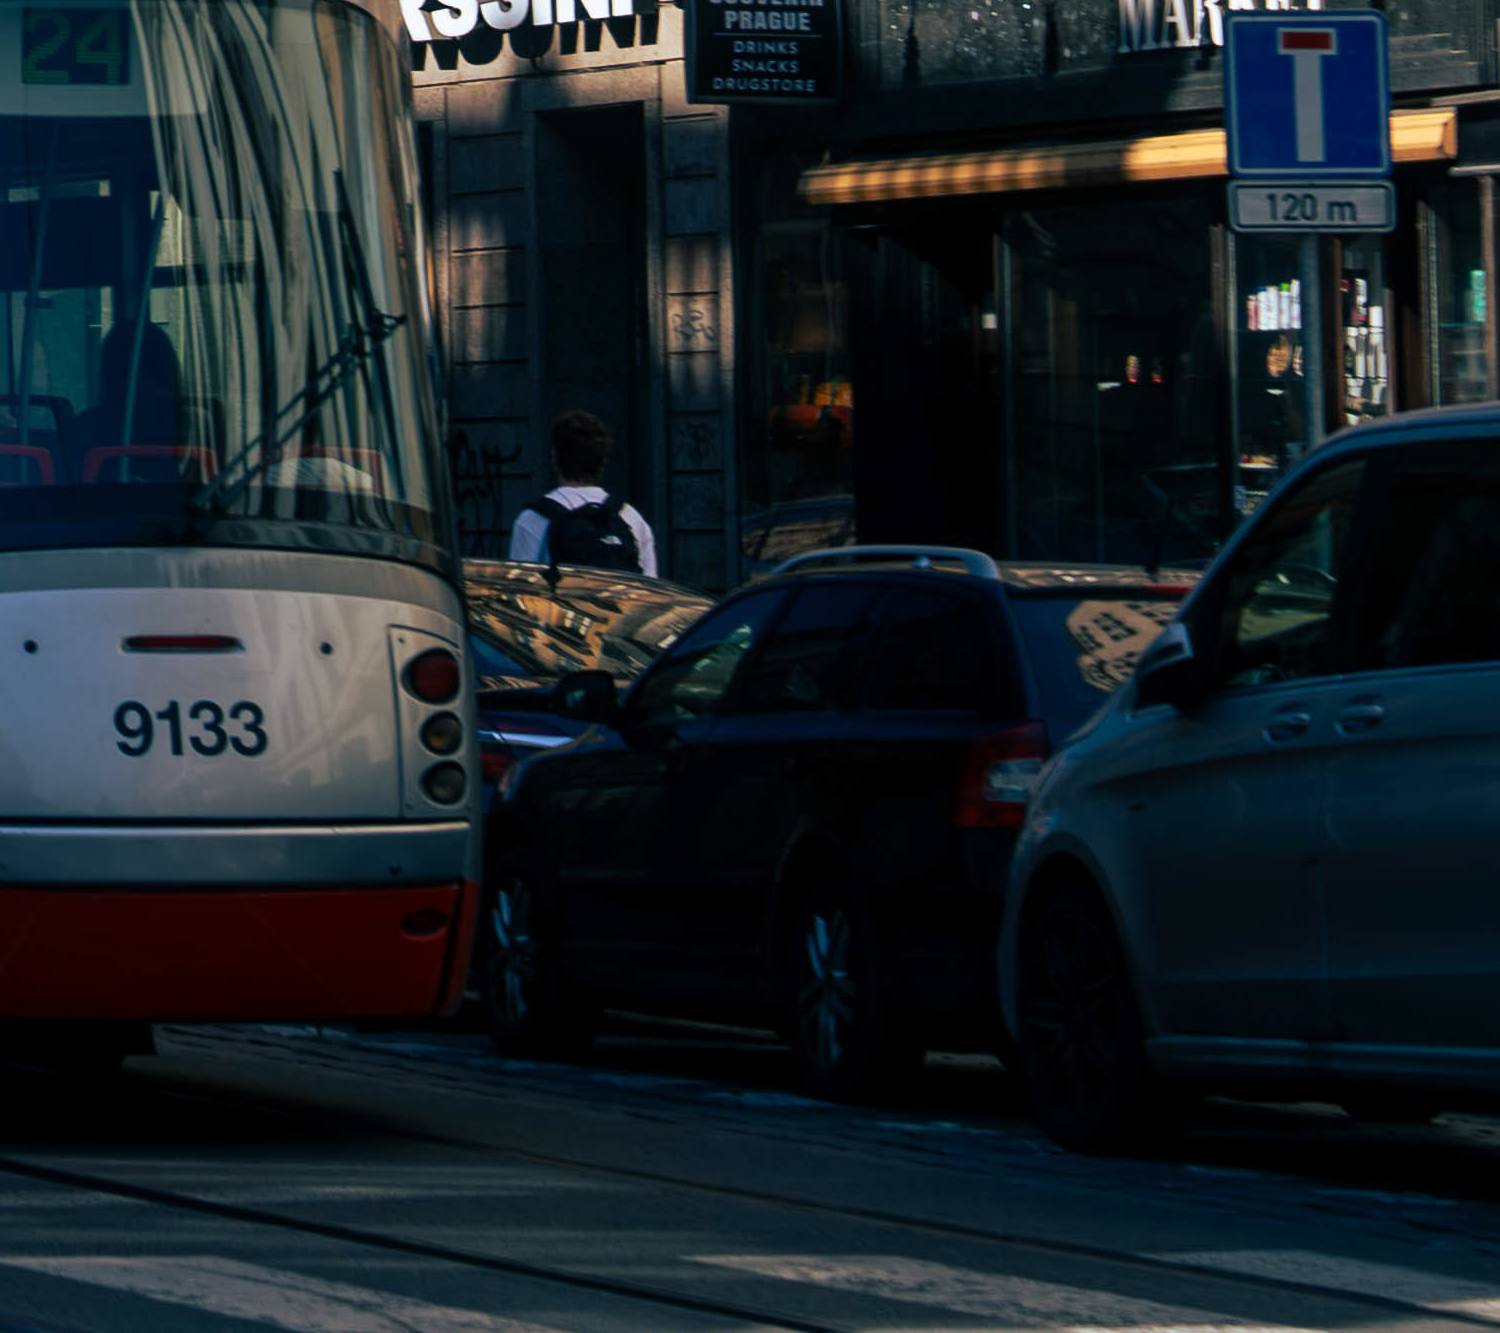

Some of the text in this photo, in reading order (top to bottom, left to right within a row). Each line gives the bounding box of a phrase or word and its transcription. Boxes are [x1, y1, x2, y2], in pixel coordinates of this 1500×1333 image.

[723, 9, 813, 32] PRAGUE
[732, 40, 800, 55] DRINKS
[731, 58, 800, 75] SNACKS
[710, 76, 818, 94] DRUGSTORE
[1266, 193, 1358, 223] 120 m
[113, 700, 268, 757] 9133
